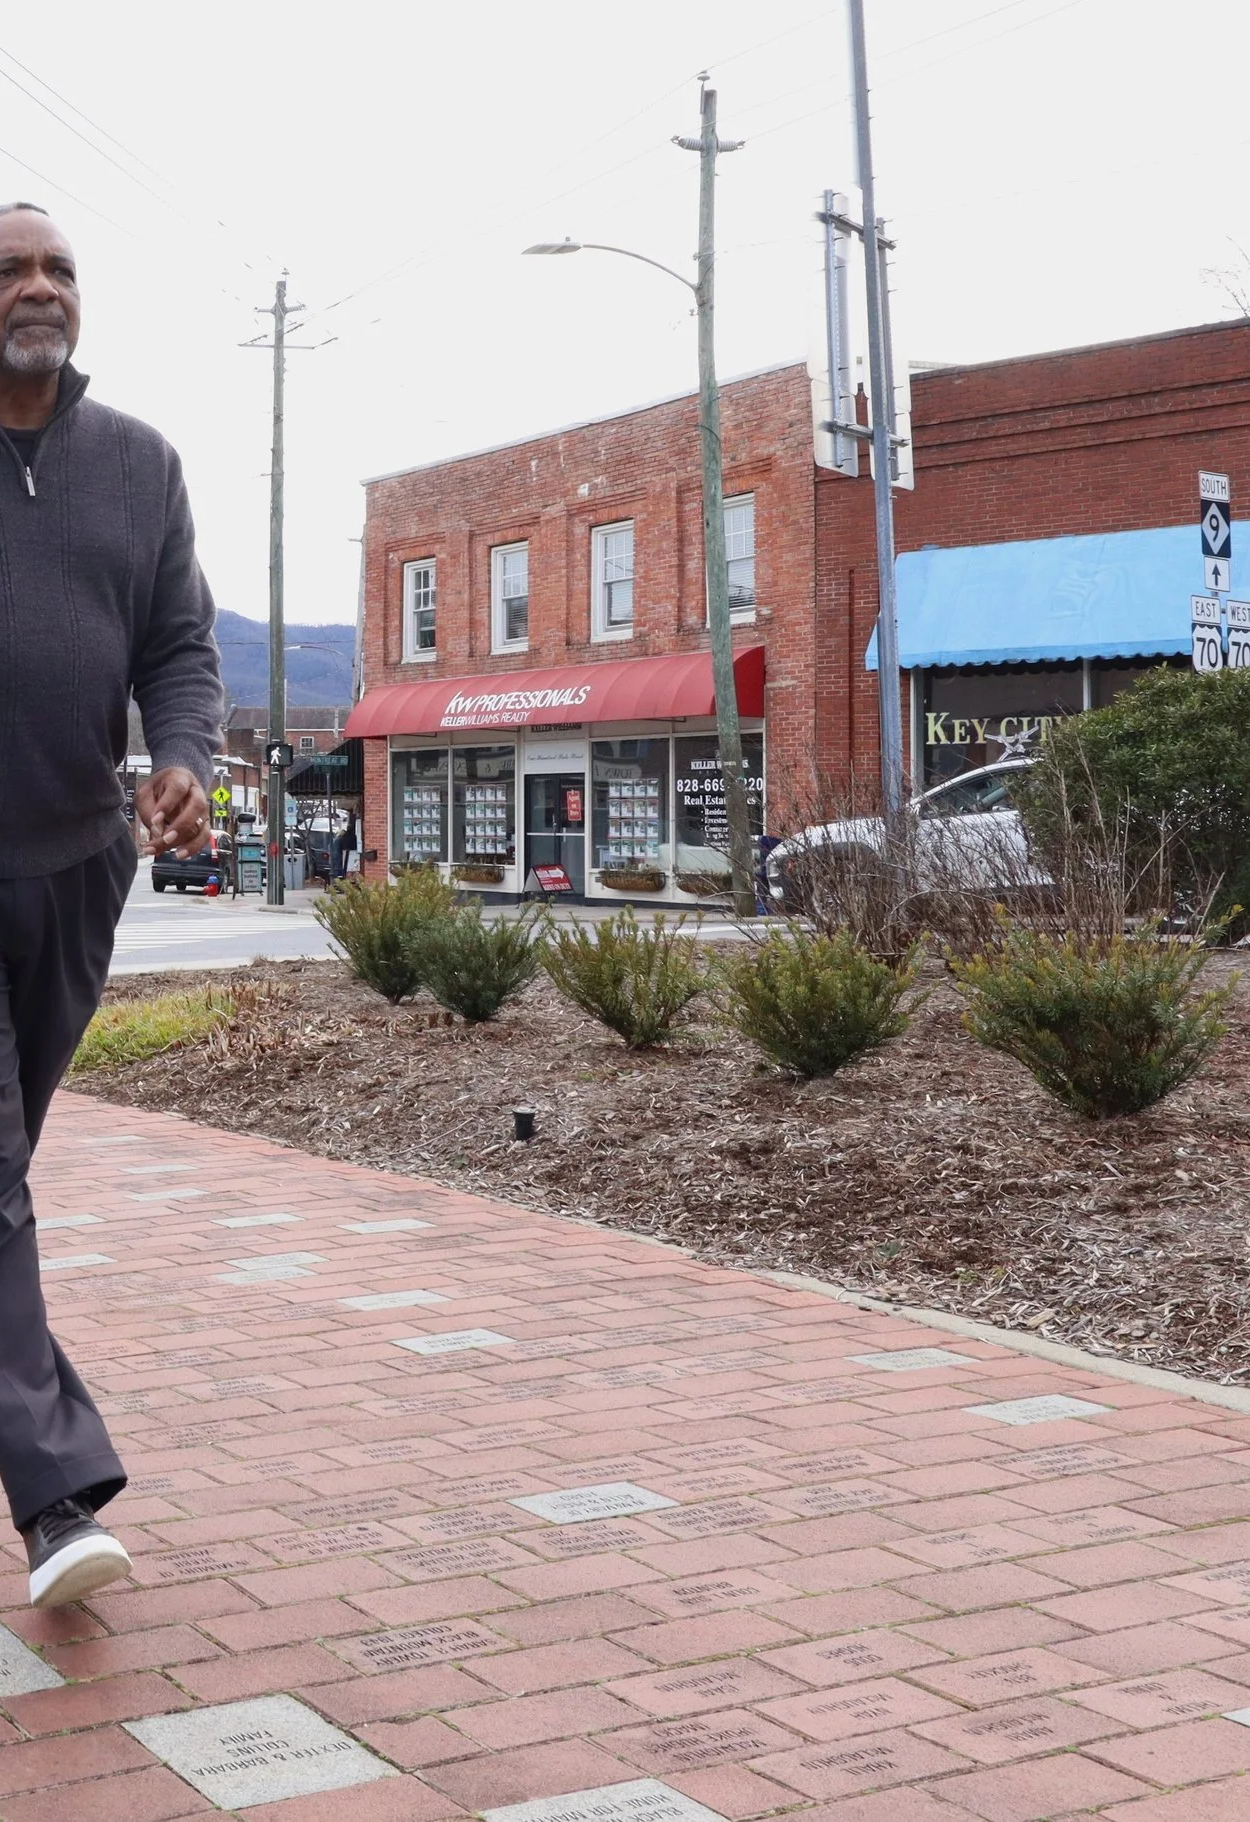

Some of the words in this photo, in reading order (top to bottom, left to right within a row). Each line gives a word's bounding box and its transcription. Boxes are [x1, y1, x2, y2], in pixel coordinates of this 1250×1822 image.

[1201, 478, 1227, 495] SOUTH
[1209, 514, 1220, 542] 9
[1195, 600, 1217, 618] EAST
[1230, 605, 1250, 621] WEST
[1196, 637, 1219, 668] 70
[1231, 641, 1250, 668] 70
[473, 685, 591, 713] PROFESSIONALS
[500, 711, 531, 723] REALTY
[925, 712, 991, 745] KEY
[1000, 715, 1063, 745] CIT
[691, 760, 716, 770] KELLER
[684, 795, 703, 805] Real
[399, 1625, 453, 1640] COLLEGE
[434, 1631, 481, 1644] BLACK
[362, 1639, 434, 1659] MOUNTAIN
[449, 1638, 498, 1653] SARAH
[375, 1650, 431, 1668] TOWERY
[217, 1729, 274, 1747] FAMILY
[226, 1739, 292, 1759] COLLINS
[289, 1740, 352, 1761] DEXTER
[191, 1755, 270, 1778] BARBARA
[588, 1801, 621, 1816] FOR
[623, 1794, 670, 1809] HOME
